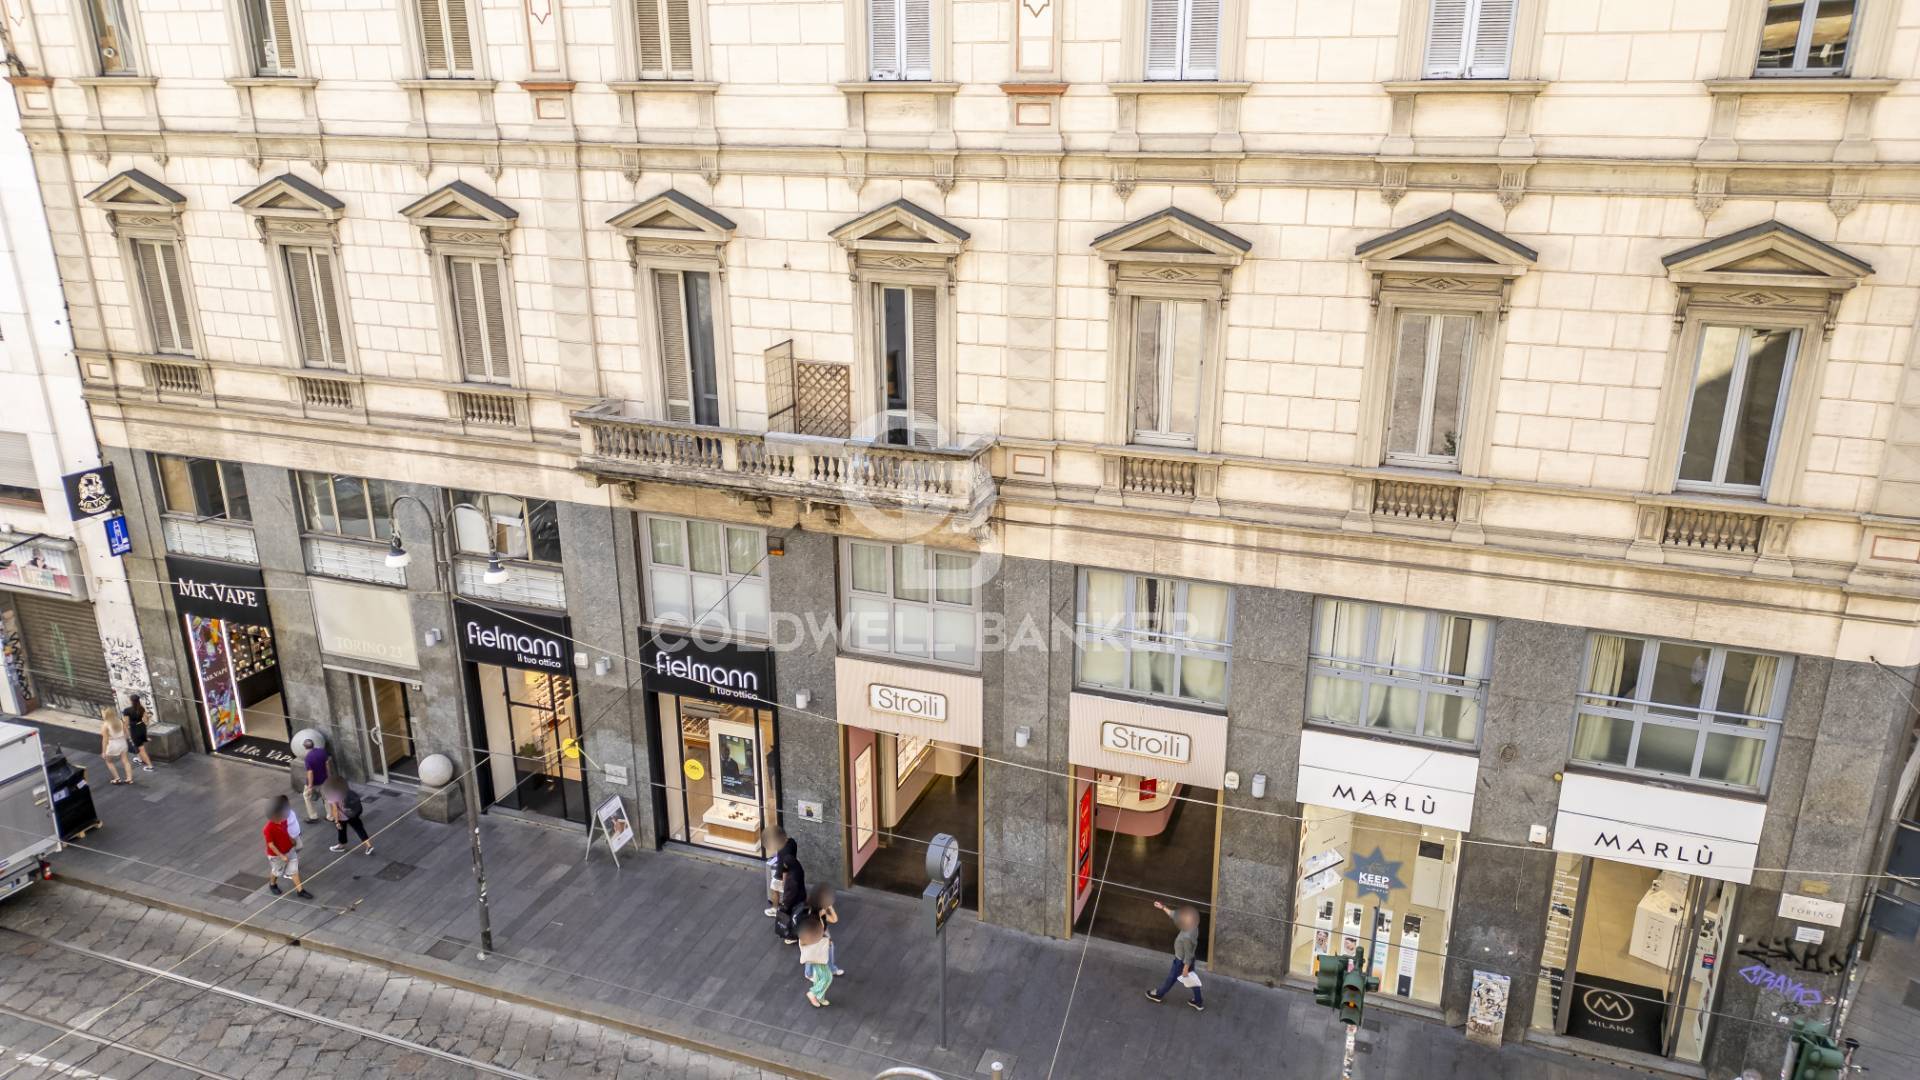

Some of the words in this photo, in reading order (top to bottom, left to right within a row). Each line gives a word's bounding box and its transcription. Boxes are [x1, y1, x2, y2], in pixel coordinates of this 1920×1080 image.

[524, 655, 537, 665] tuo
[538, 658, 561, 669] ottico
[716, 686, 731, 696] tuo
[878, 688, 938, 717] Stroili
[1112, 726, 1180, 758] Stroili
[266, 749, 296, 763] VAP
[1332, 784, 1436, 815] MARLÙ
[1594, 832, 1713, 865] MARLÙ
[1359, 871, 1390, 884] KEEP
[1588, 1019, 1635, 1034] MILANO
